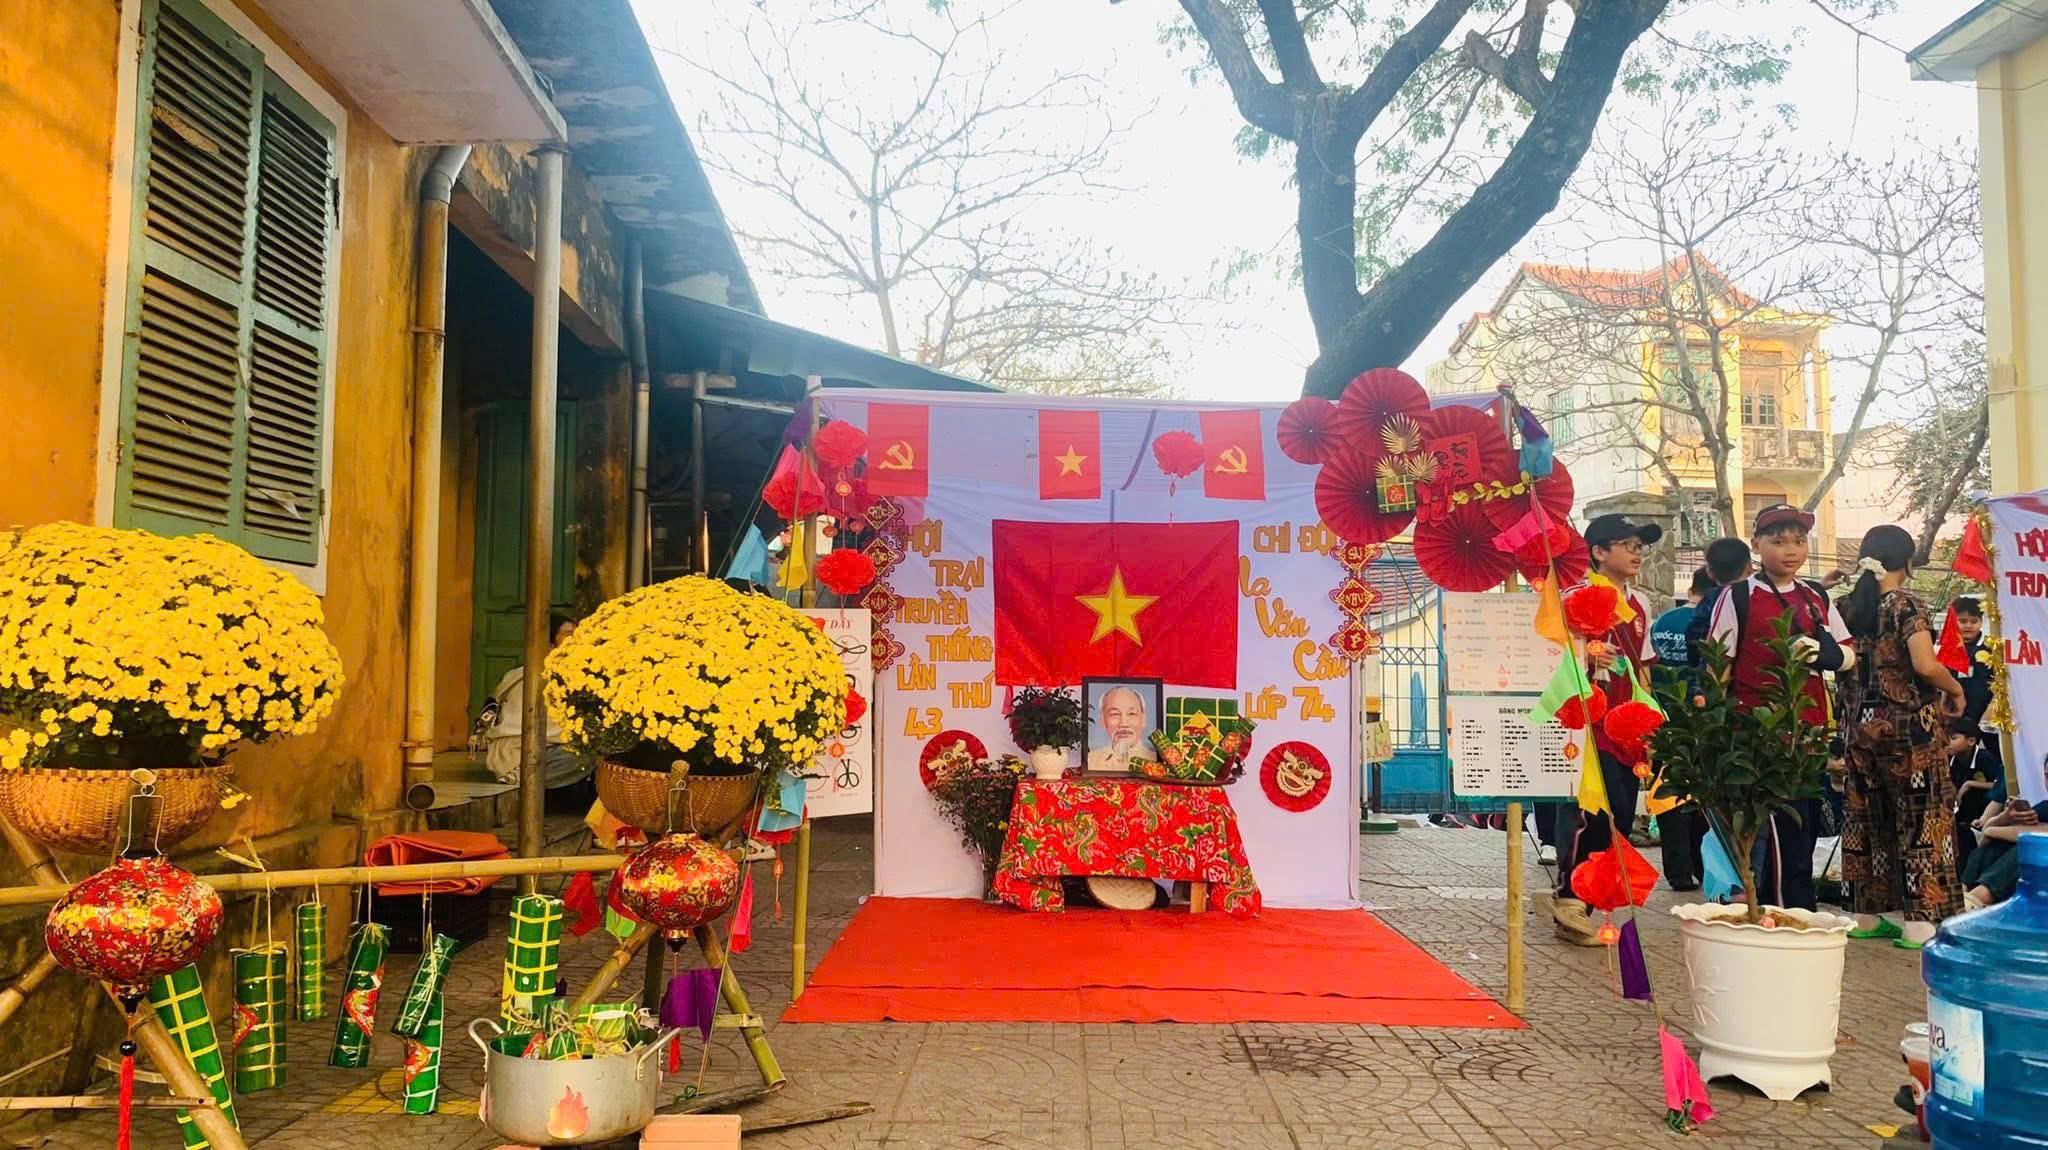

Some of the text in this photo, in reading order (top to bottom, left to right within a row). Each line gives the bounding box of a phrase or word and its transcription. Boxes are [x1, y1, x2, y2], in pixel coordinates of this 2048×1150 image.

[901, 518, 943, 557] HỘI
[929, 556, 984, 591] TRẠI
[895, 588, 969, 625] TRUYỀN
[1255, 597, 1310, 638] Văn
[926, 626, 993, 662] THỐNG
[897, 652, 936, 690] LẦN
[948, 670, 996, 708] THỨ
[1245, 685, 1335, 722] LỚP 74
[904, 707, 943, 740] 43
